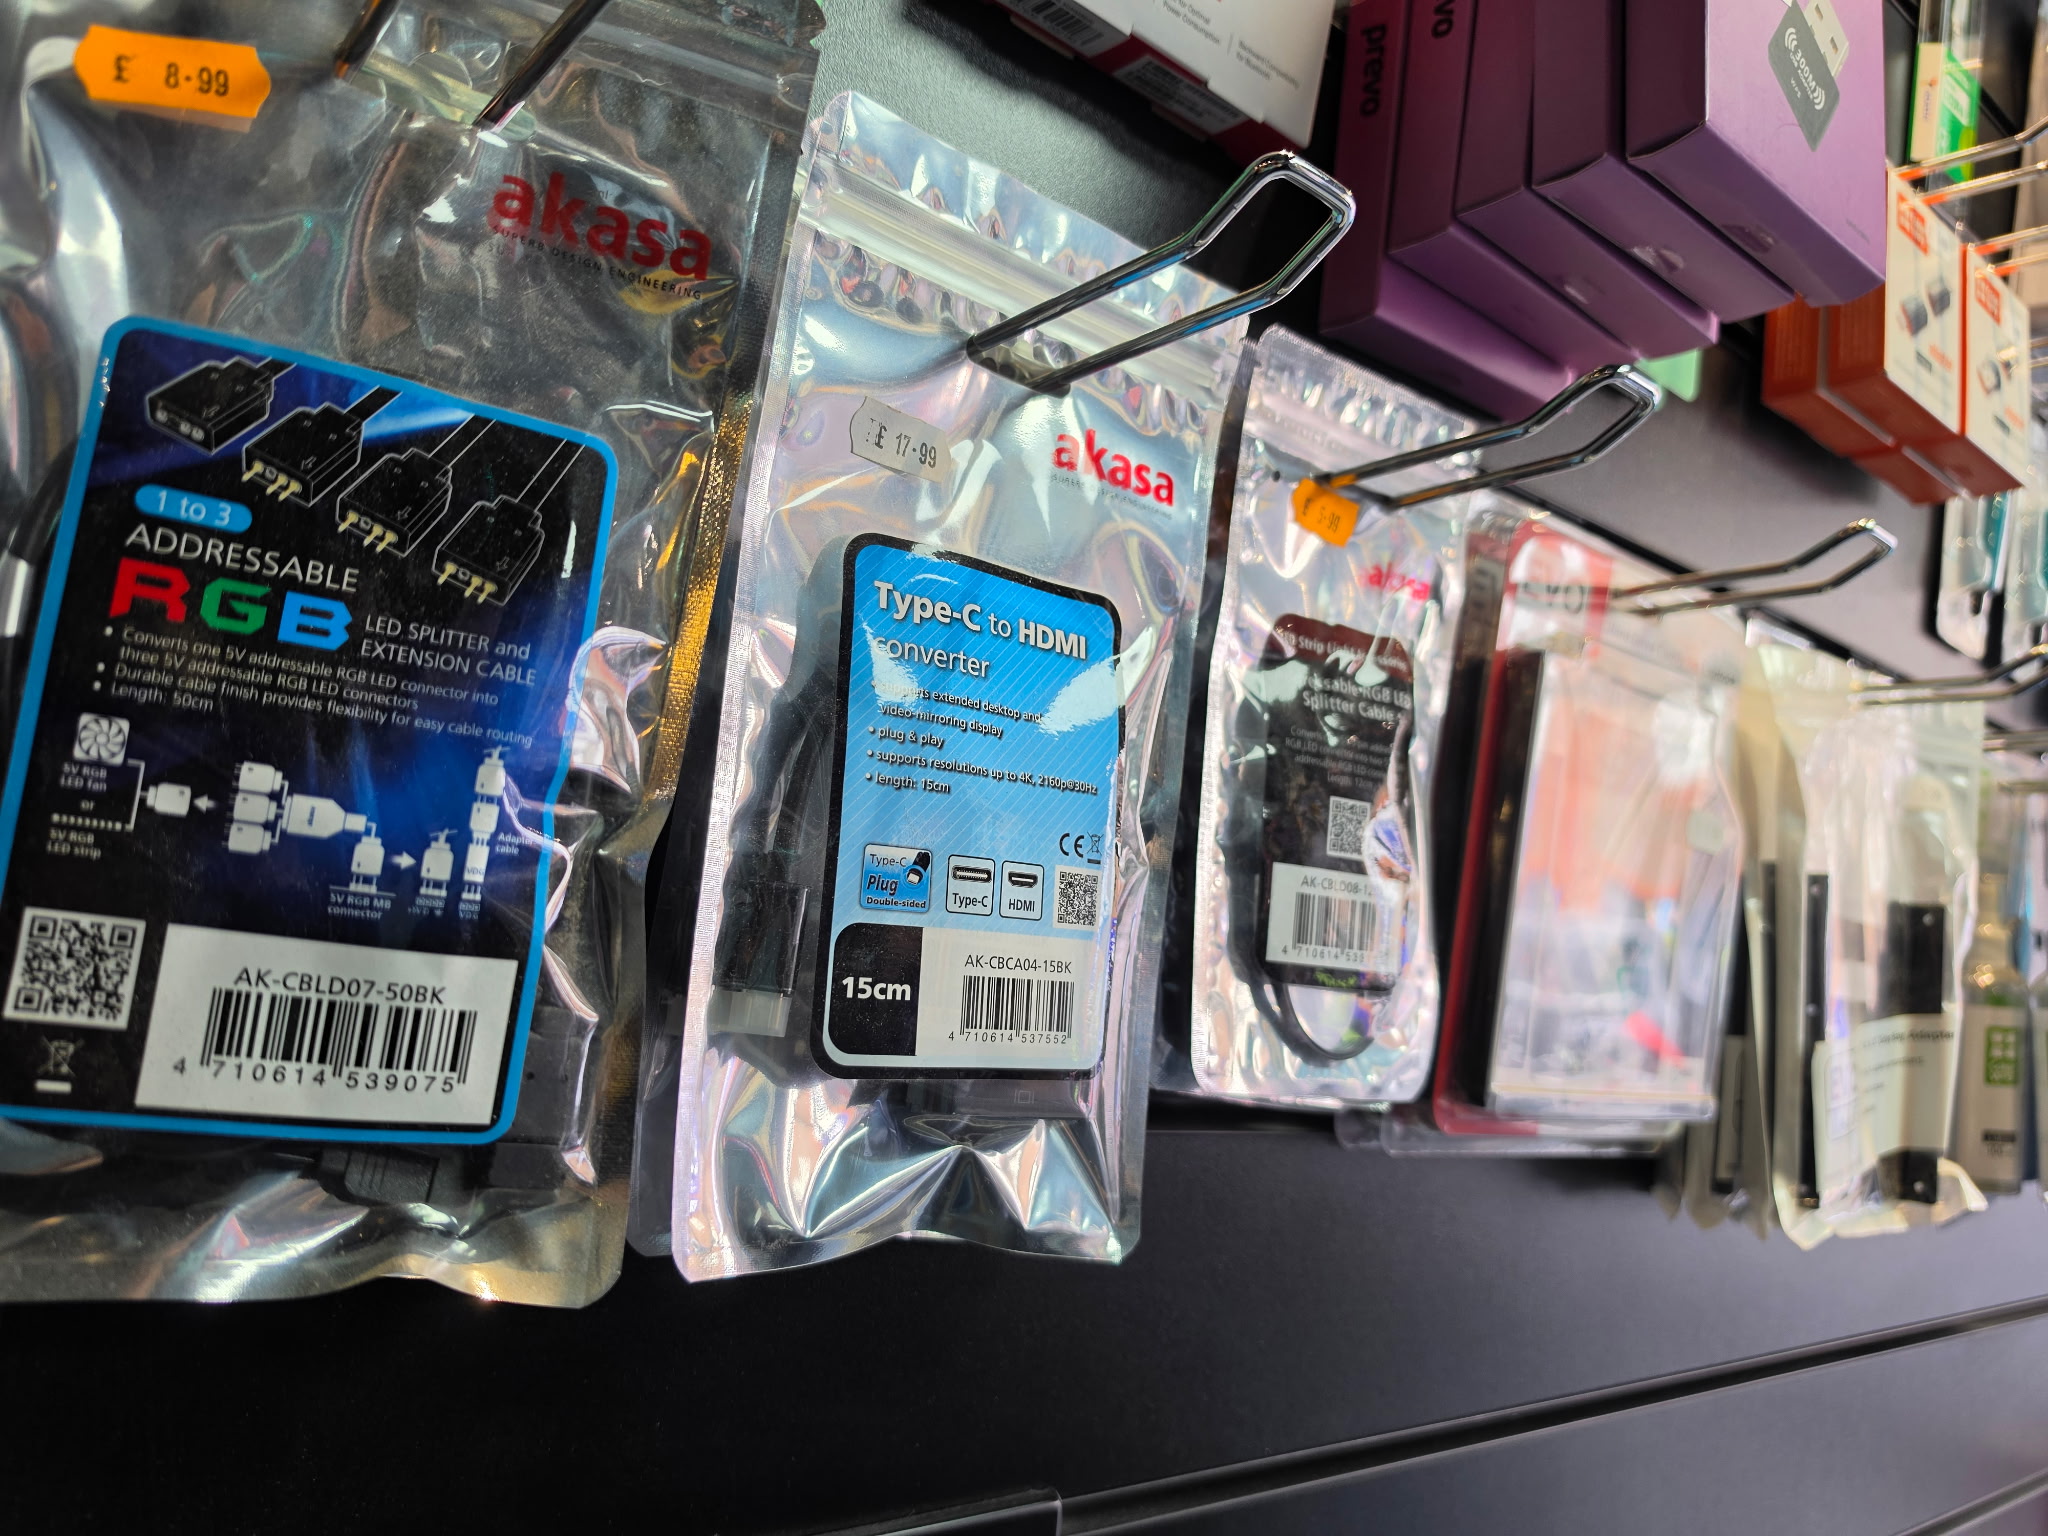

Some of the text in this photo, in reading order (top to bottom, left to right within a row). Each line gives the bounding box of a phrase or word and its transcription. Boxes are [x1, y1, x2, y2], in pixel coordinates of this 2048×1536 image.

[112, 53, 131, 84] £
[1360, 23, 1387, 118] prevo
[1795, 49, 1817, 91] 300M
[491, 171, 713, 282] akasa
[493, 224, 702, 301] SUPERB DESIGN ENGINEERING
[873, 423, 888, 450] £
[1051, 428, 1176, 508] akasa
[157, 489, 233, 527] 1 to 3
[124, 522, 361, 594] ADDRESSABLE
[108, 556, 354, 652] RGB
[873, 580, 1088, 661] Type-C to HDMI
[365, 613, 532, 661] LED SPLITTER and
[1298, 635, 1325, 655] Strip
[121, 626, 500, 706] Converts one 5V addressable RGB LED connector into
[360, 637, 538, 687] EXTENSION CABLE
[873, 634, 991, 679] converter
[119, 645, 420, 712] three 5V addressable RGB LED connectors
[110, 679, 215, 713] Length: 50cm
[114, 661, 534, 749] Durable cable finish provides flexibility for easy cable routing
[881, 681, 1043, 724] supports extended desktop and
[1302, 689, 1395, 721] Splitter Cable
[880, 703, 1004, 739] video-mirroring display
[878, 725, 945, 750] plug & play
[59, 774, 108, 793] LED fan
[82, 765, 108, 779] RGB
[875, 770, 951, 794] length: 15cm
[876, 748, 1098, 795] supports resolutions up to 4K, 2160p@30Hz
[79, 799, 96, 812] or
[68, 831, 96, 845] RGB
[495, 844, 520, 856] cable
[1059, 832, 1086, 859] CE
[73, 845, 103, 862] strip
[869, 852, 908, 868] Type-C
[465, 865, 487, 878] VDG
[865, 872, 900, 896] Plug
[327, 904, 384, 921] connector
[329, 892, 393, 910] 5V RGB MB
[865, 896, 928, 910] Double-sided
[951, 892, 990, 909] Type-C
[1007, 897, 1036, 913] HDMI
[964, 954, 1073, 975] AK-CBCA04-15BK
[1281, 944, 1288, 956] 4
[233, 965, 447, 1006] AK-CBLD07-50BK
[841, 975, 912, 1003] 15cm
[948, 1030, 1068, 1045] 4 710614 537552
[172, 1056, 456, 1094] 4 710614 539075
